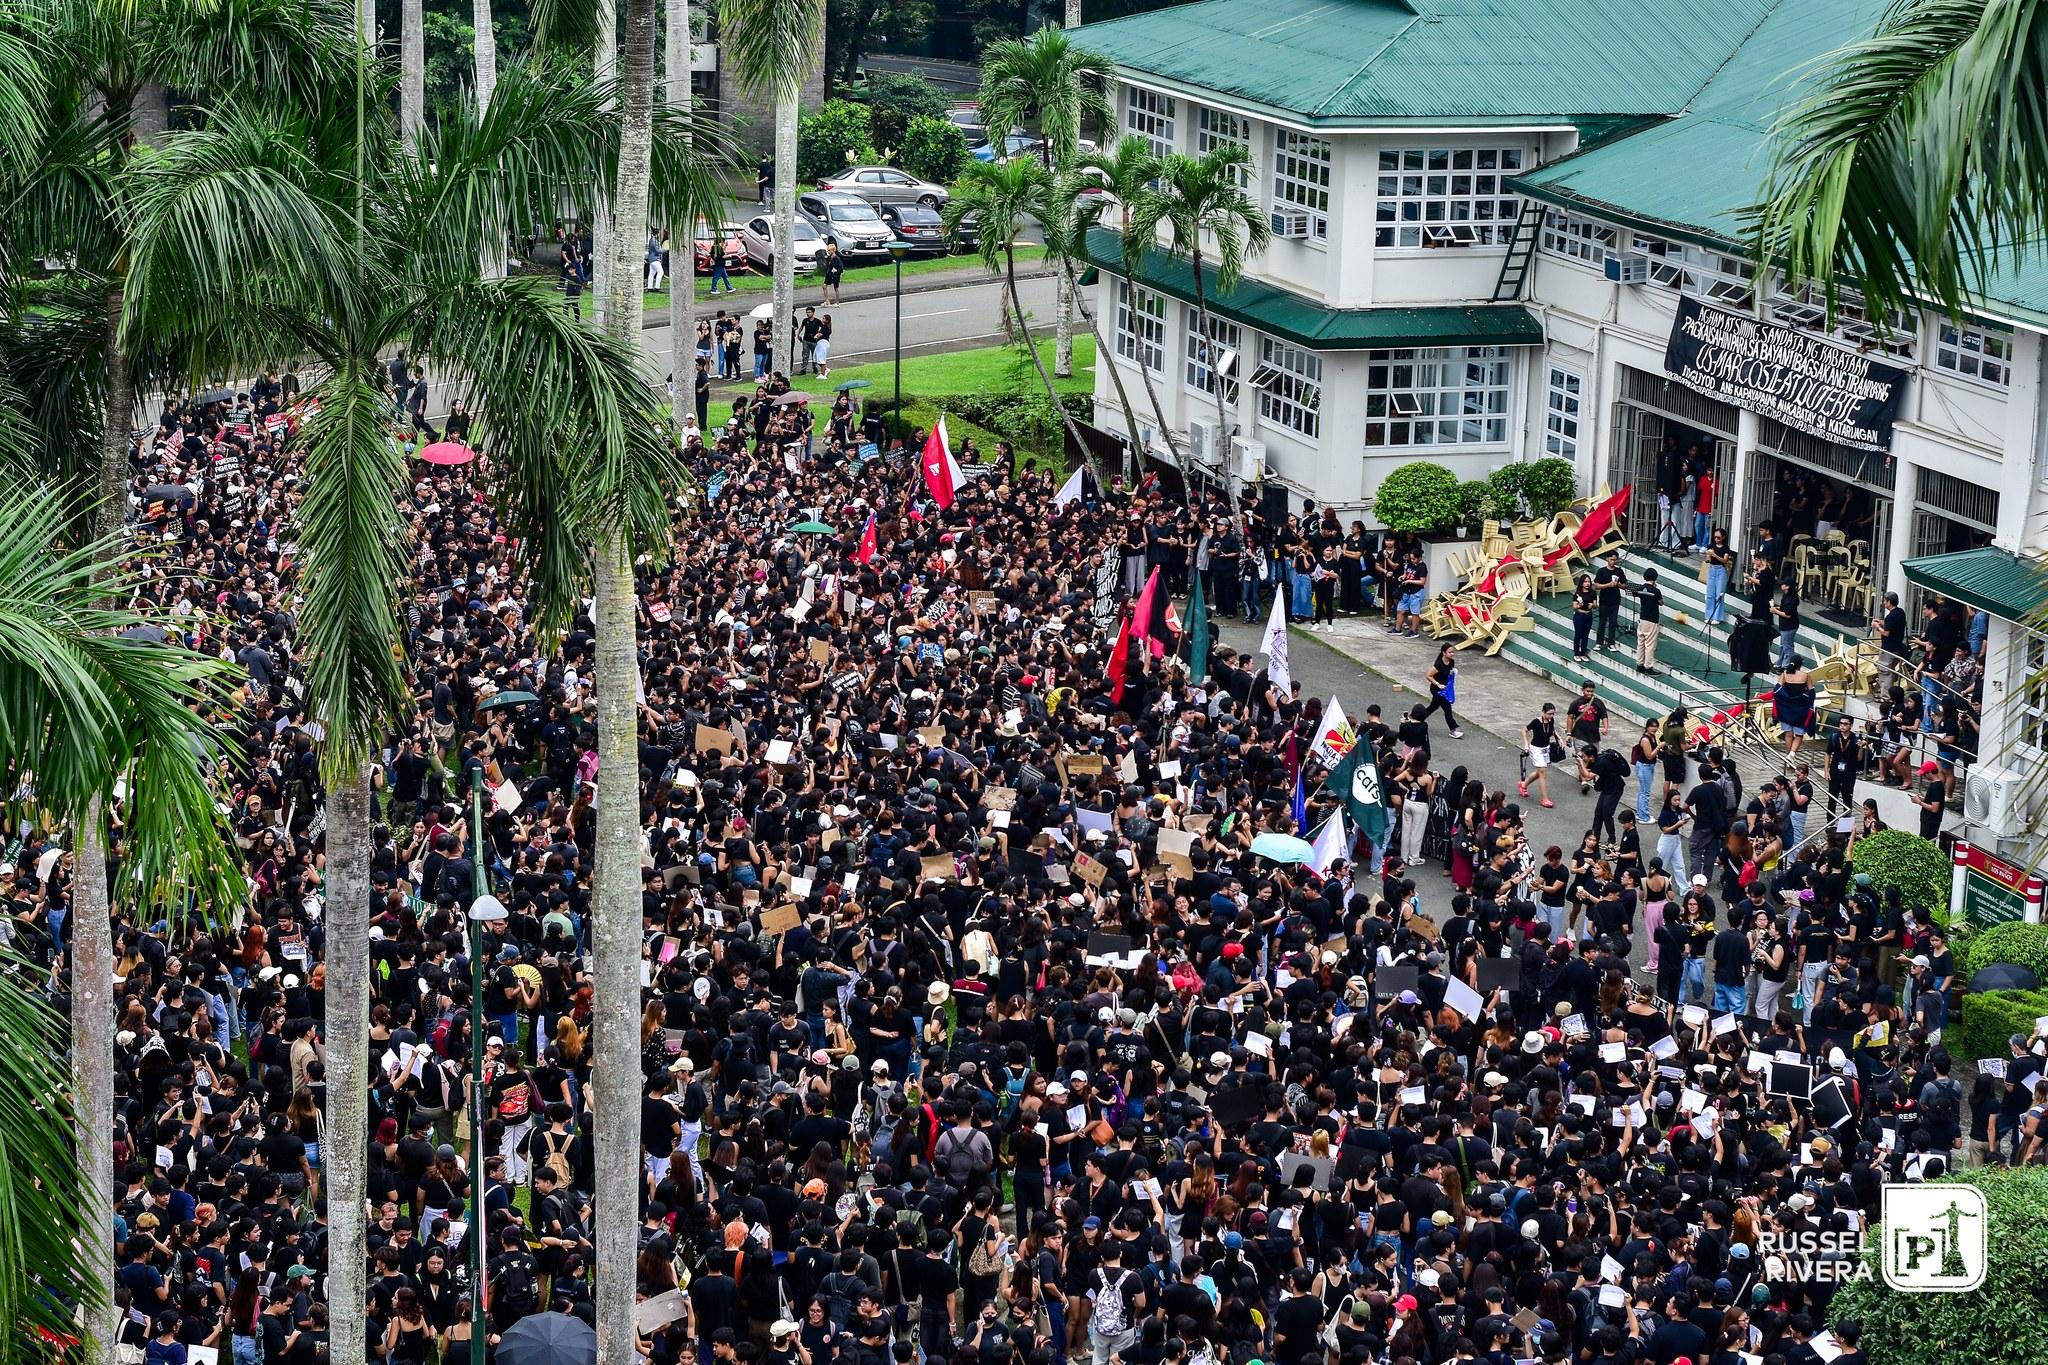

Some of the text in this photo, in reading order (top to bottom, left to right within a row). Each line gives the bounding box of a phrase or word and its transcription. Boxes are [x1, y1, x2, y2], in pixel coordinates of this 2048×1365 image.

[1681, 315, 1732, 350] PAGKAISAHIN
[1731, 332, 1748, 356] PARA
[1747, 339, 1761, 358] SA
[1790, 349, 1827, 382] IBAGSAK
[1825, 367, 1848, 389] ANG
[1698, 306, 1725, 329] AGHAM
[1724, 314, 1737, 332] AT
[1761, 326, 1804, 353] SANDATA
[1803, 340, 1820, 359] NG
[1819, 345, 1870, 377] KABATAAN
[1696, 343, 1774, 391] US-MARCOS
[1776, 370, 1806, 400] AT
[1793, 378, 1867, 425] DUTERTE
[1720, 380, 1734, 395] ANG
[1776, 398, 1818, 424] NAKABATAY
[1816, 414, 1827, 430] SA
[1828, 420, 1879, 443] KATARUNGAN
[1897, 1112, 1918, 1121] RESS
